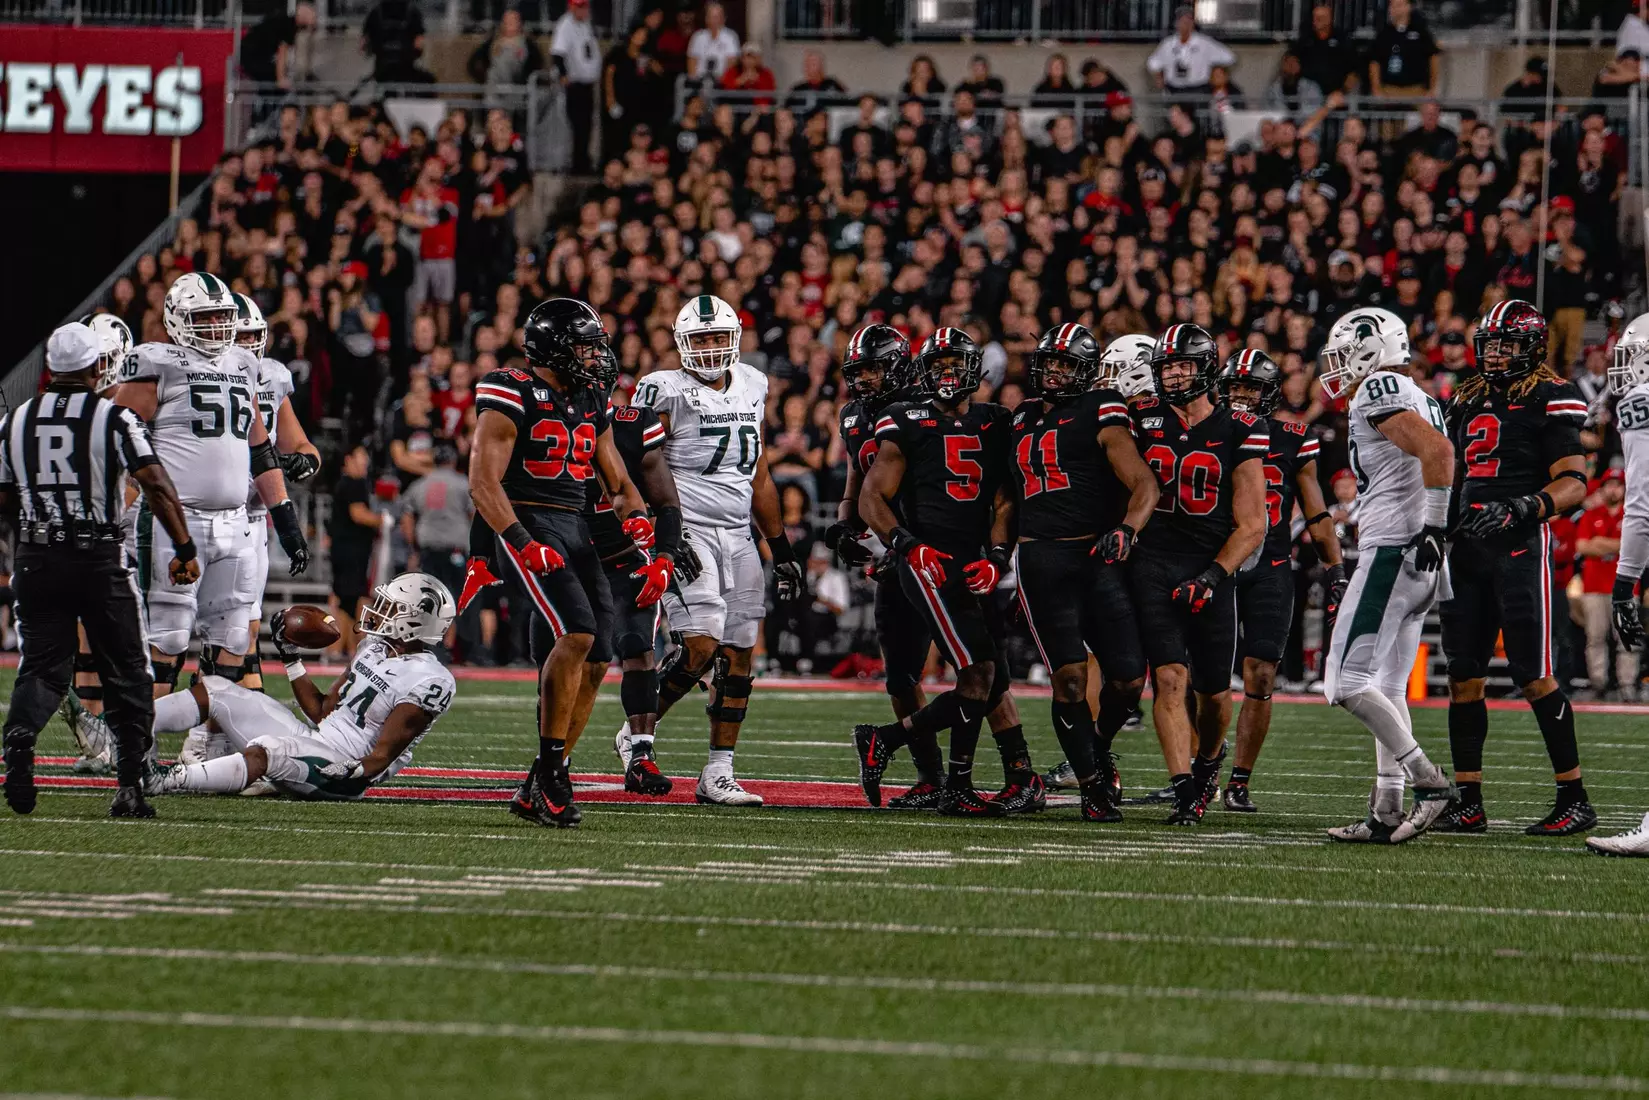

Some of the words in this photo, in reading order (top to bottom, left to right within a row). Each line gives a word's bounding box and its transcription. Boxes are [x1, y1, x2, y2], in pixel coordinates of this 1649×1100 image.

[0, 62, 203, 136] EYES
[186, 373, 229, 383] MICHIGAN
[229, 374, 248, 385] STATE
[257, 391, 275, 401] TATE
[635, 382, 659, 406] 70
[1365, 375, 1400, 400] 80
[190, 384, 252, 440] 56
[700, 413, 739, 424] MICHIGAN
[739, 412, 757, 423] STATE
[1619, 397, 1649, 429] 55
[35, 424, 79, 485] R
[699, 425, 759, 476] 70
[1016, 429, 1071, 500] 11
[1465, 413, 1501, 478] 2
[943, 434, 983, 501] 5
[1144, 443, 1223, 515] 20
[370, 674, 391, 693] STATE
[422, 683, 453, 712] 24
